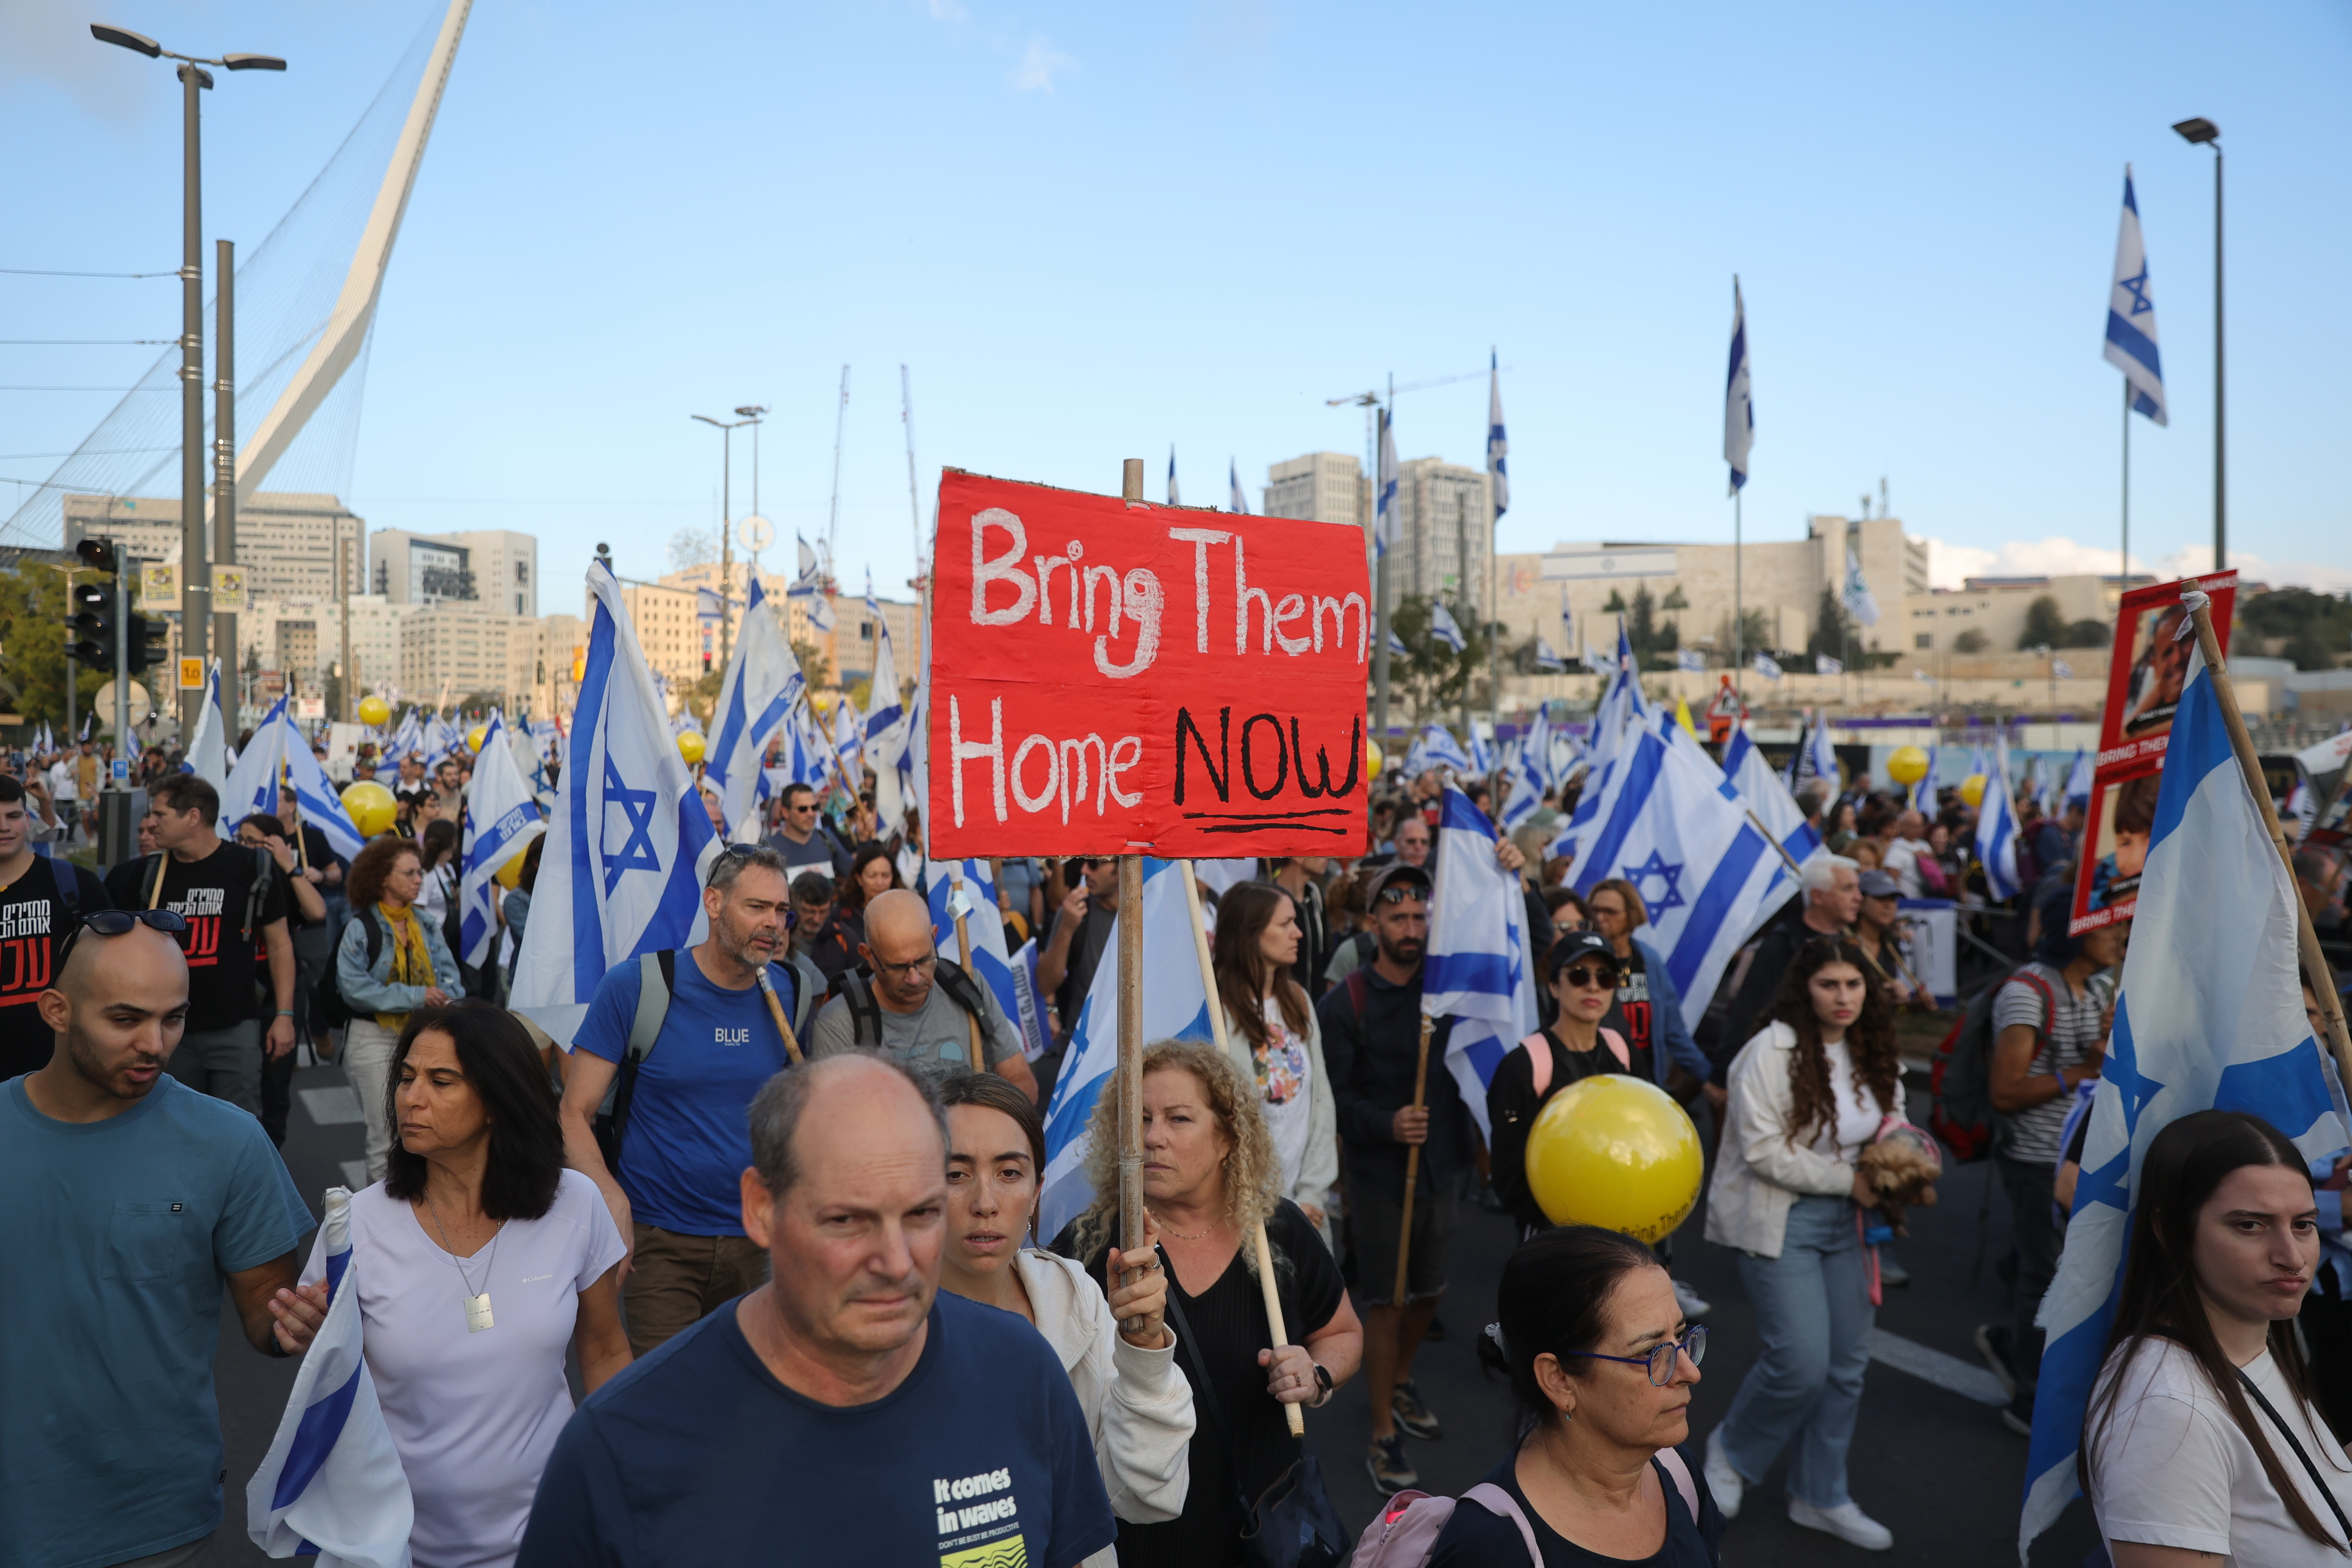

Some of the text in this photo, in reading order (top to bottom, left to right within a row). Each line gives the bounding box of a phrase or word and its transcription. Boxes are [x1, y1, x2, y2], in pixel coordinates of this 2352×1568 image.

[971, 507, 1366, 679] Bring Them
[950, 695, 1360, 828] Home NOW
[2096, 743, 2138, 767] BRING
[187, 888, 224, 903] מחזירים
[3, 899, 51, 922] מחזירים
[197, 902, 223, 916] אותם
[18, 916, 51, 936] אותם
[715, 1028, 750, 1043] BLUE
[527, 1273, 553, 1282] Columbia
[934, 1467, 1011, 1504] It comes
[937, 1496, 1017, 1535] in waves
[938, 1538, 959, 1550] DON'T
[967, 1533, 981, 1543] BUSY
[981, 1531, 989, 1539] BE
[988, 1522, 1020, 1537] PRODUCTIVE
